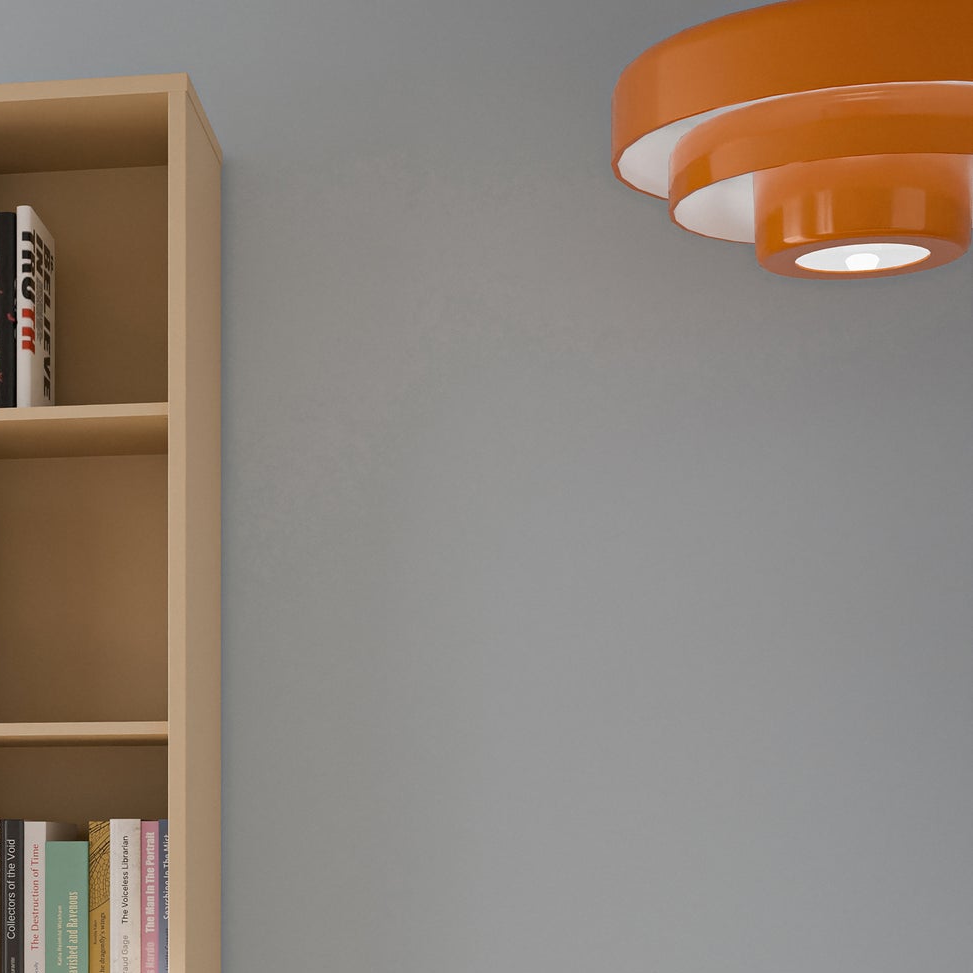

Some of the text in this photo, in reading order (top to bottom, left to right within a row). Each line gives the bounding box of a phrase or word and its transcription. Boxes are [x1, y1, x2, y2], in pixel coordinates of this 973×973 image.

[35, 232, 43, 278] IN
[21, 229, 36, 355] TRUTH
[42, 242, 52, 402] BELIEVE
[5, 840, 15, 939] Collectors of the Void
[31, 868, 38, 877] of
[144, 832, 155, 932] The Man In The Portrait
[31, 880, 39, 931] Destruction
[67, 892, 78, 927] Ravenous
[31, 934, 39, 950] The
[67, 930, 78, 943] and
